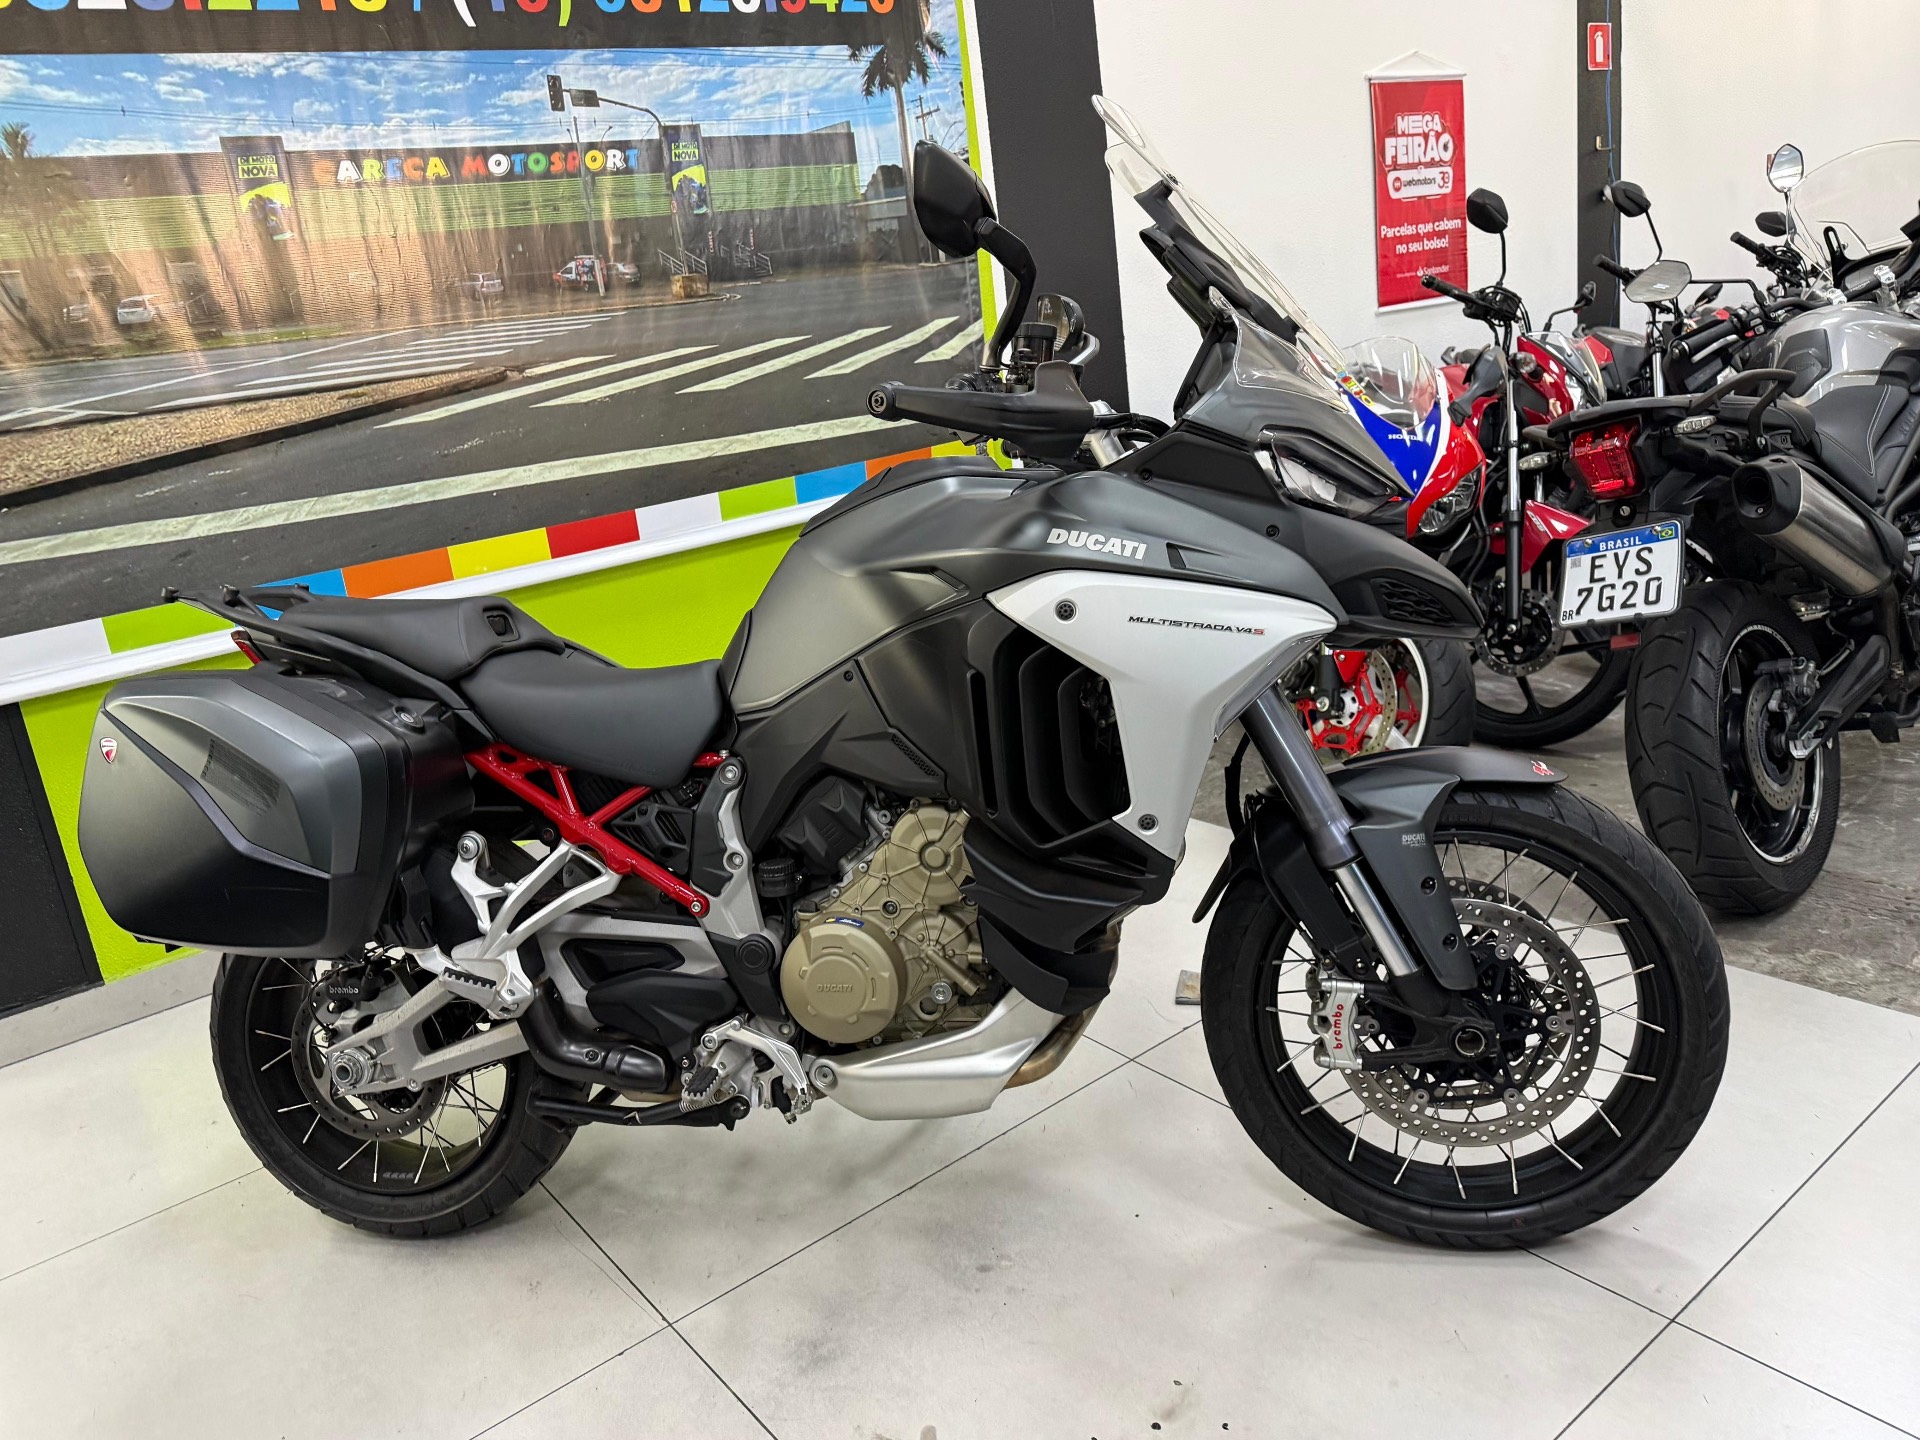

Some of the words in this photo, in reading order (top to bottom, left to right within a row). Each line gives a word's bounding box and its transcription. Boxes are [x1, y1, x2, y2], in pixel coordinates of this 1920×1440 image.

[1397, 114, 1442, 135] MEGA
[673, 150, 698, 161] NOVA
[1385, 131, 1454, 165] FEIRÃO
[241, 165, 276, 177] NOVA
[461, 149, 639, 177] MOTOSPORT
[1403, 177, 1436, 187] webmotors
[1381, 223, 1417, 238] Parcelas
[1417, 222, 1434, 236] que
[1434, 217, 1461, 231] cabem
[1396, 244, 1408, 254] no
[1408, 241, 1423, 252] seu
[1424, 235, 1449, 250] bolso!
[1423, 265, 1450, 274] Santander
[1047, 528, 1147, 560] DUCATI
[1600, 536, 1642, 551] BRASIL
[1589, 547, 1654, 584] EYS
[1575, 577, 1663, 616] 7G20
[1562, 609, 1574, 621] BR
[1128, 616, 1233, 633] MULTISTRADA
[1235, 626, 1266, 635] V4S
[1402, 833, 1425, 842] DUCATI
[329, 985, 359, 994] brembo
[817, 984, 853, 992] DUCATI
[1332, 1004, 1344, 1049] brembo
